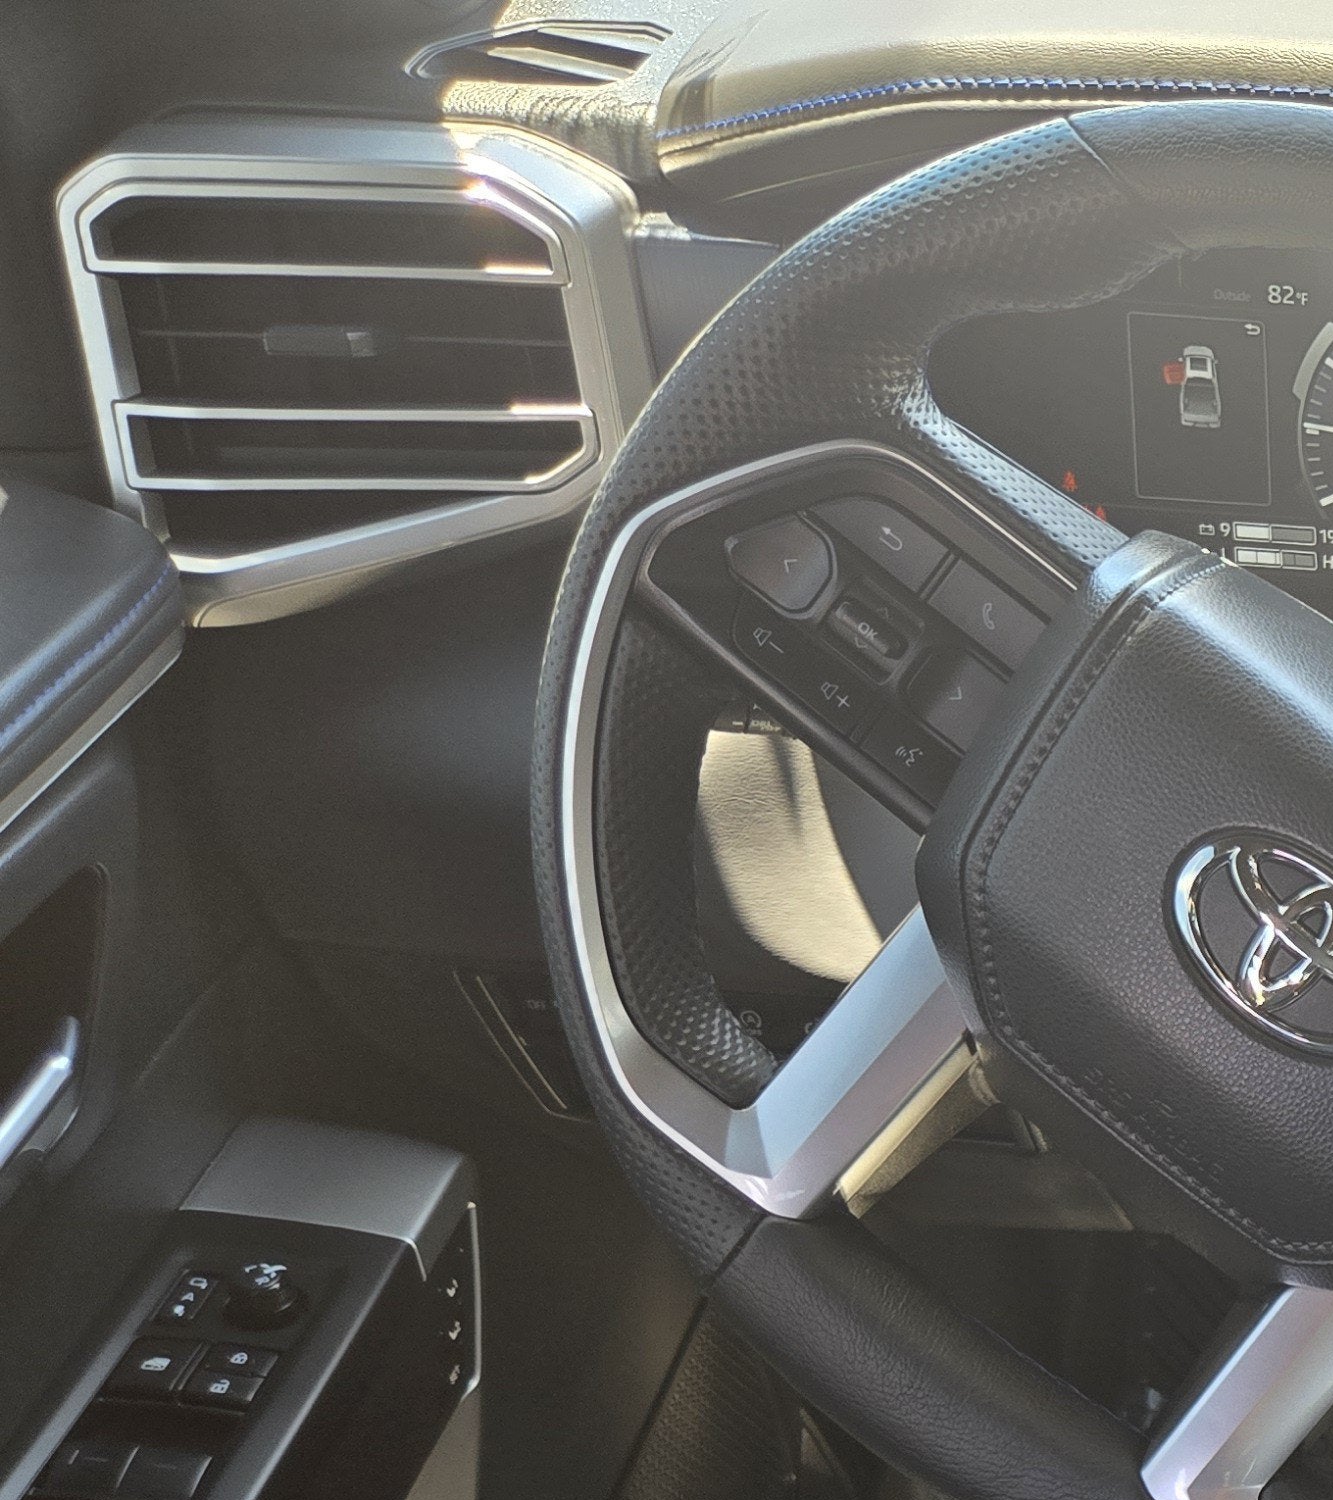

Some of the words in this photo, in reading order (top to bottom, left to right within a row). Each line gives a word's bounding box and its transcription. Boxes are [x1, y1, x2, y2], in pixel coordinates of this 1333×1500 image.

[1219, 522, 1231, 537] 9
[1322, 554, 1333, 569] H
[858, 622, 878, 642] OK
